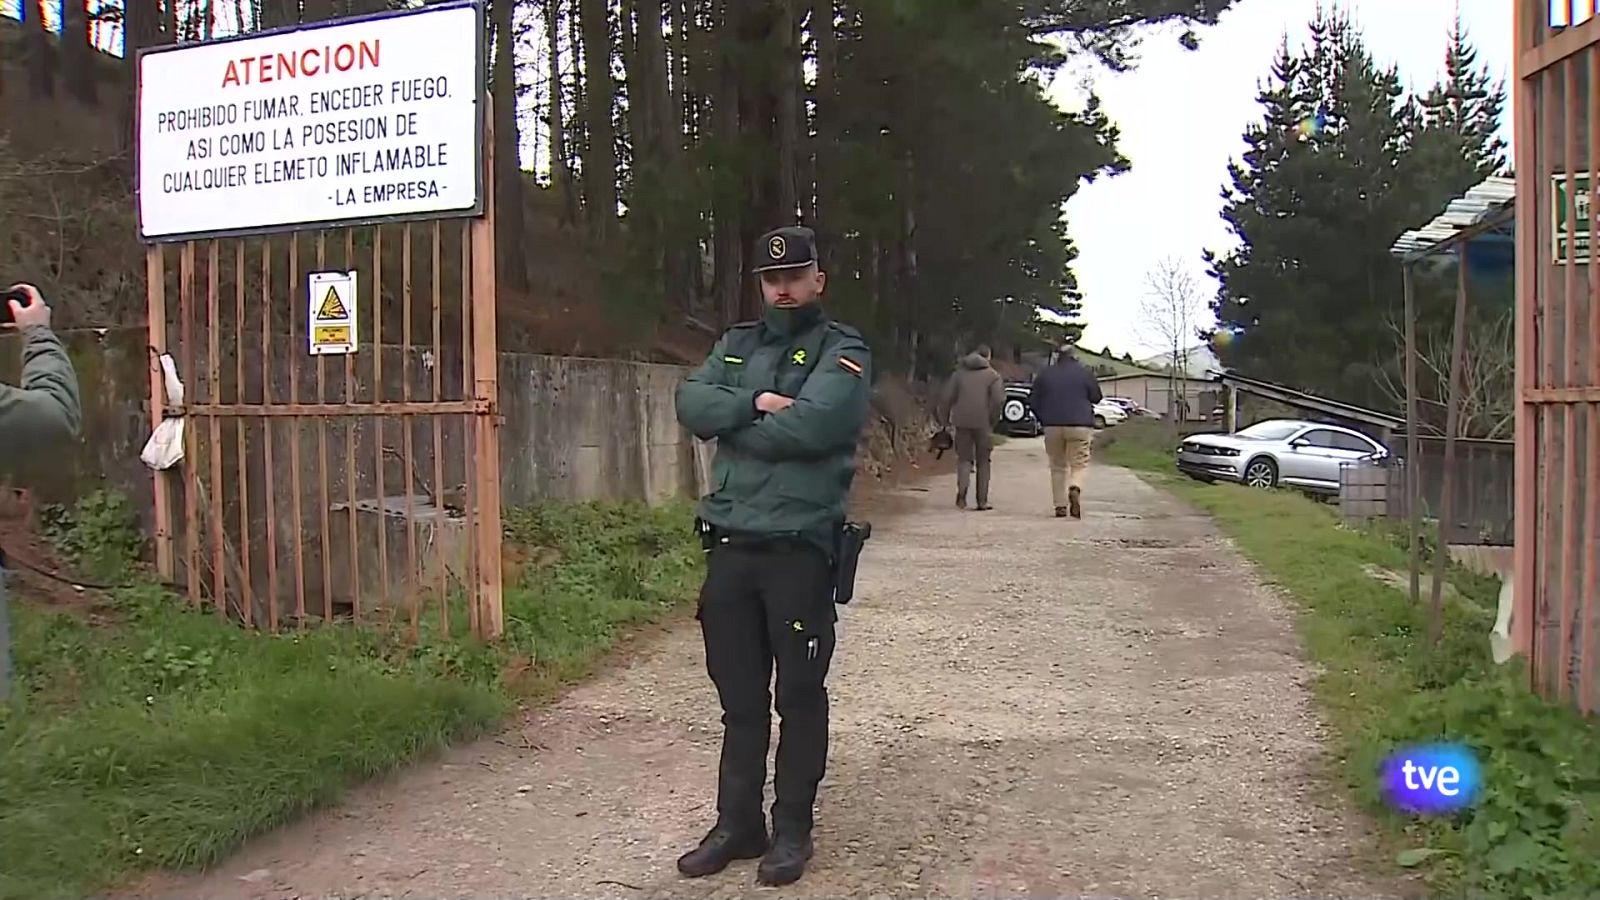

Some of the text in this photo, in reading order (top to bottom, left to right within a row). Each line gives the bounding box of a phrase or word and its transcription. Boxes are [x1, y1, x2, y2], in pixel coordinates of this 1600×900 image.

[222, 39, 380, 88] ATENCION
[158, 104, 237, 133] PROHIBIDO
[311, 84, 383, 114] ENCEDER
[186, 113, 418, 160] ASI COMO LA POSESION DE
[163, 143, 448, 193] CUALQUIER ELEMETO INFLAMABLE
